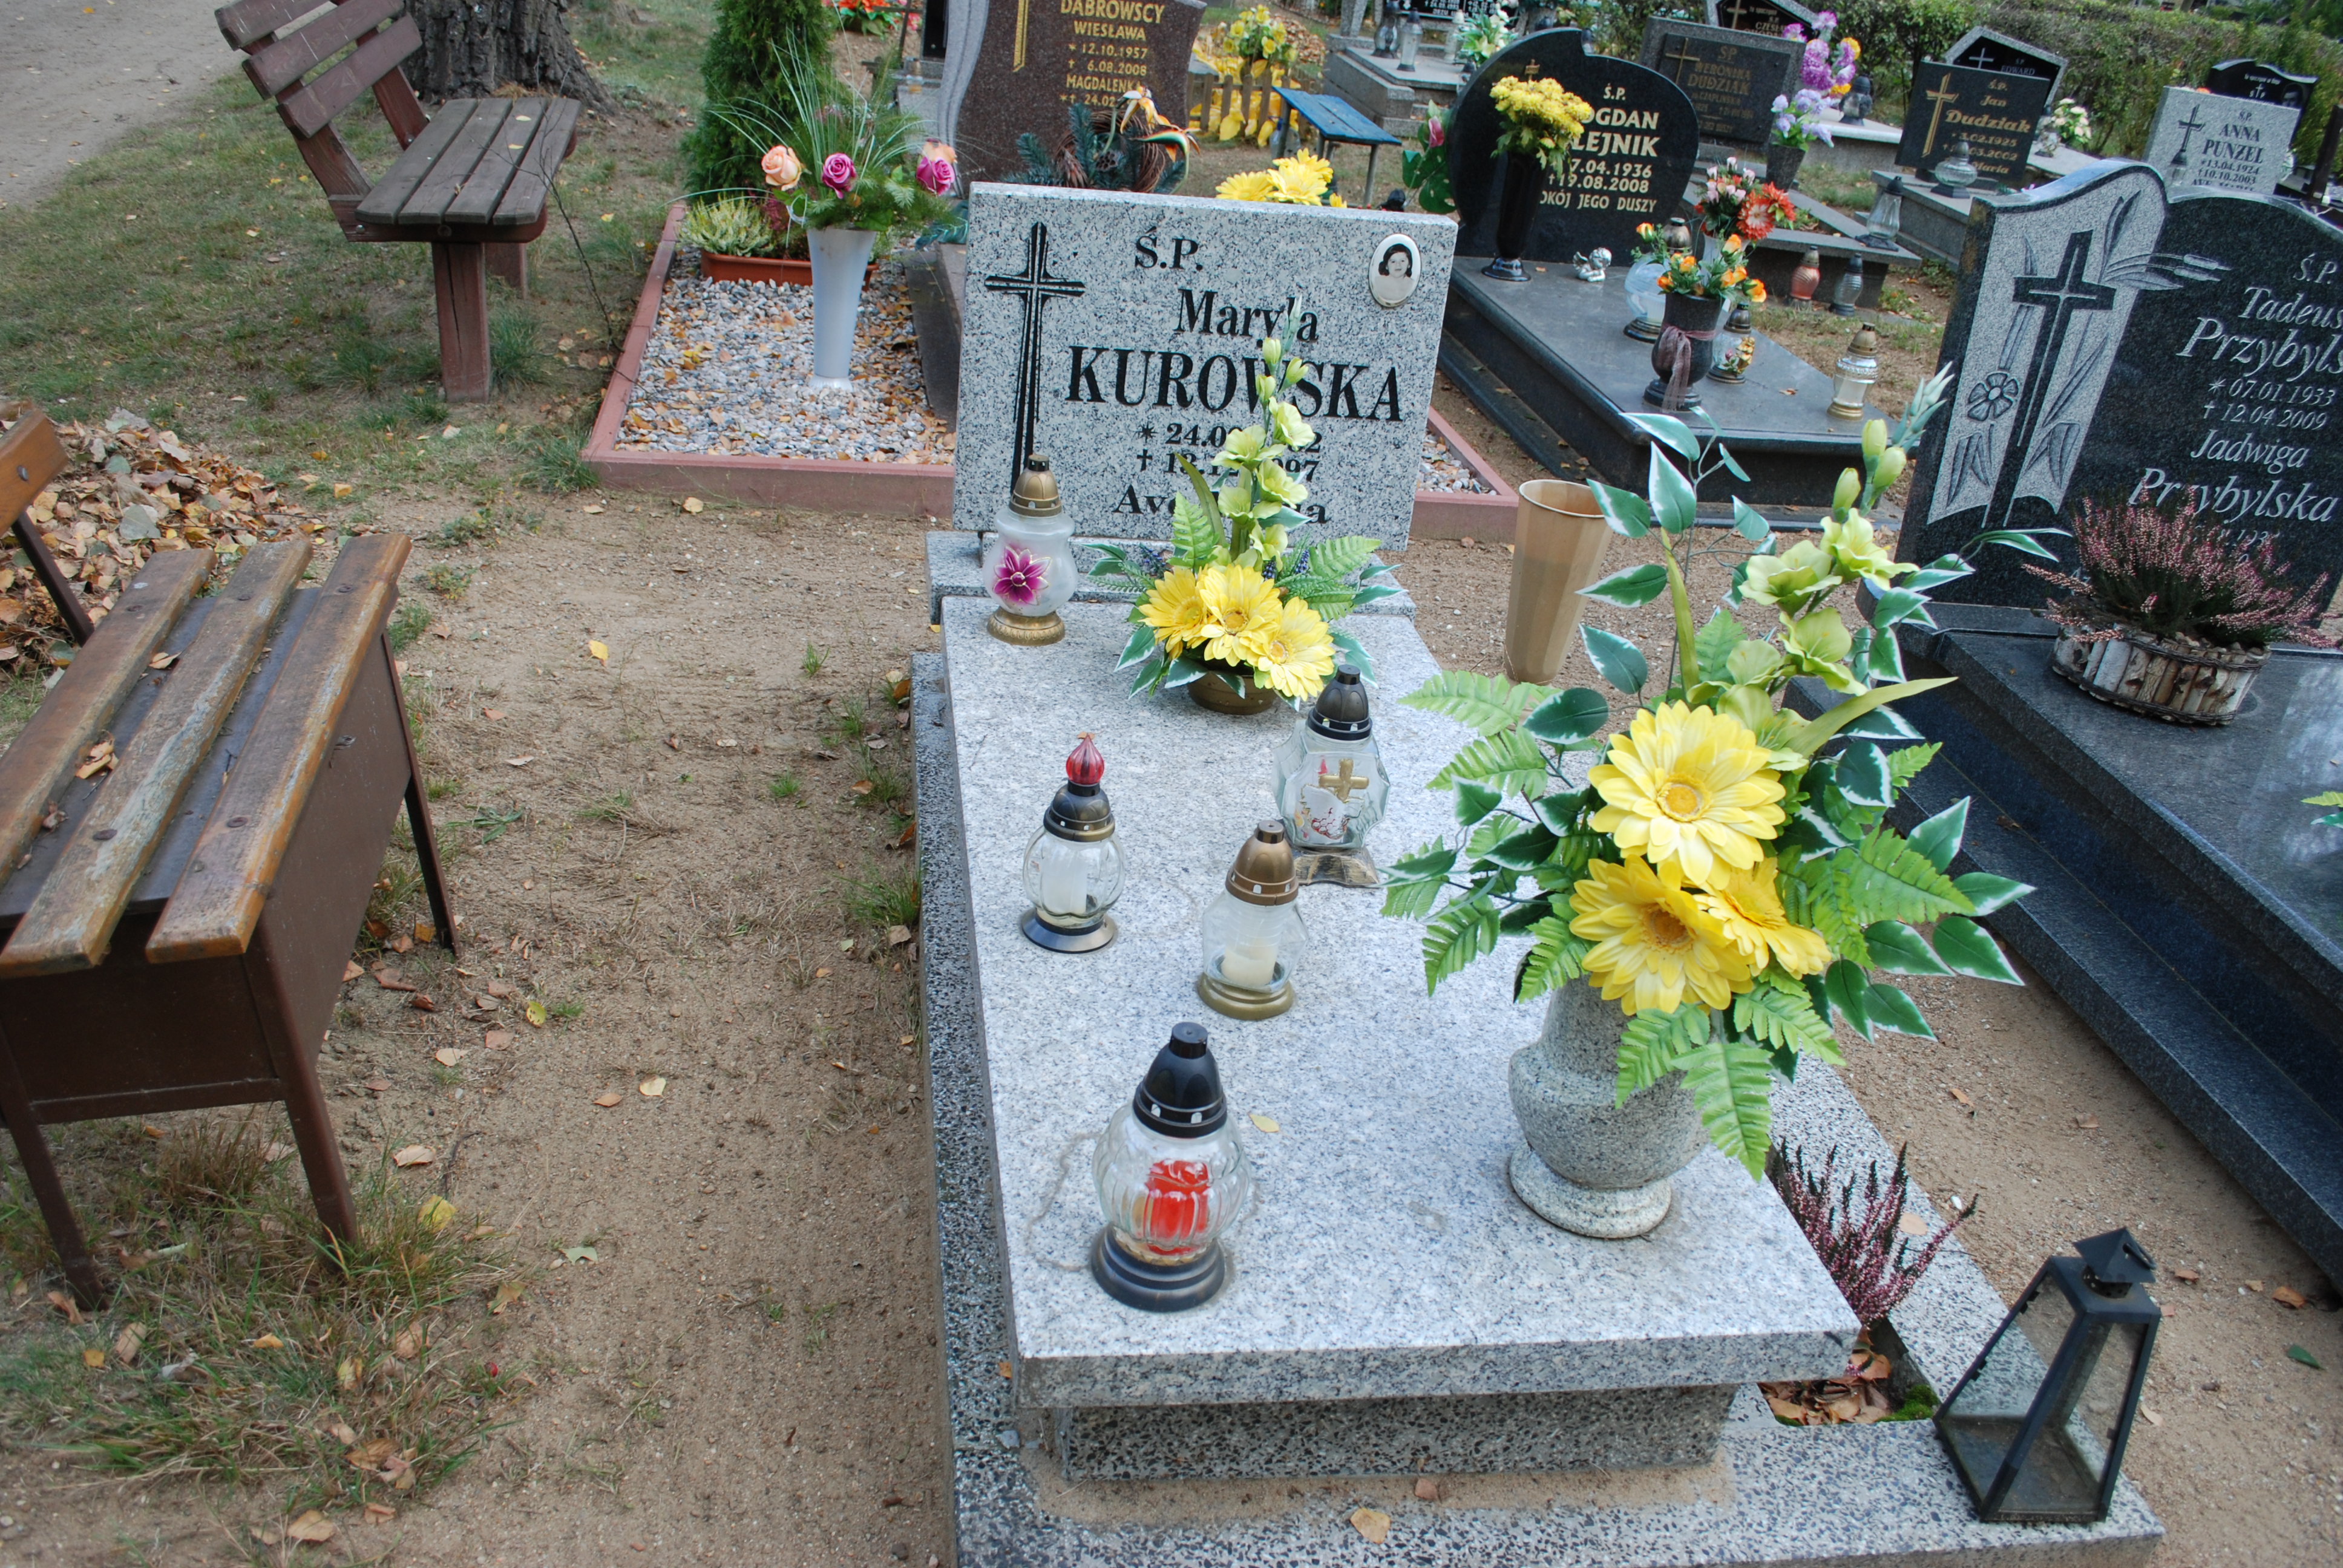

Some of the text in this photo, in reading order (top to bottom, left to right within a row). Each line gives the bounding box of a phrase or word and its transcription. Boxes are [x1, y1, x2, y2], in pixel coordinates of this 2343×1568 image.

[1073, 20, 1147, 41] WIESŁAWA
[1082, 43, 1149, 59] 12.10.1957
[1087, 59, 1147, 76] 6.08.2008
[1603, 83, 1626, 100] Ś.P.
[1687, 74, 1752, 96] DUDZIAK
[1980, 95, 2007, 107] Jan
[1944, 109, 2032, 133] Dudziak
[2220, 123, 2260, 142] ANNA
[1571, 131, 1660, 157] LEJNIK
[2202, 139, 2264, 164] PUNZEL
[2203, 168, 2256, 185] 10.10.2003
[1539, 189, 1657, 213] OKÓJ JEGO DUSZY
[1135, 226, 1203, 272] Ś.P.
[2229, 379, 2336, 406] 07.01.1933
[2221, 403, 2328, 430] 12.04.2009
[2191, 430, 2311, 474] Jadwiga
